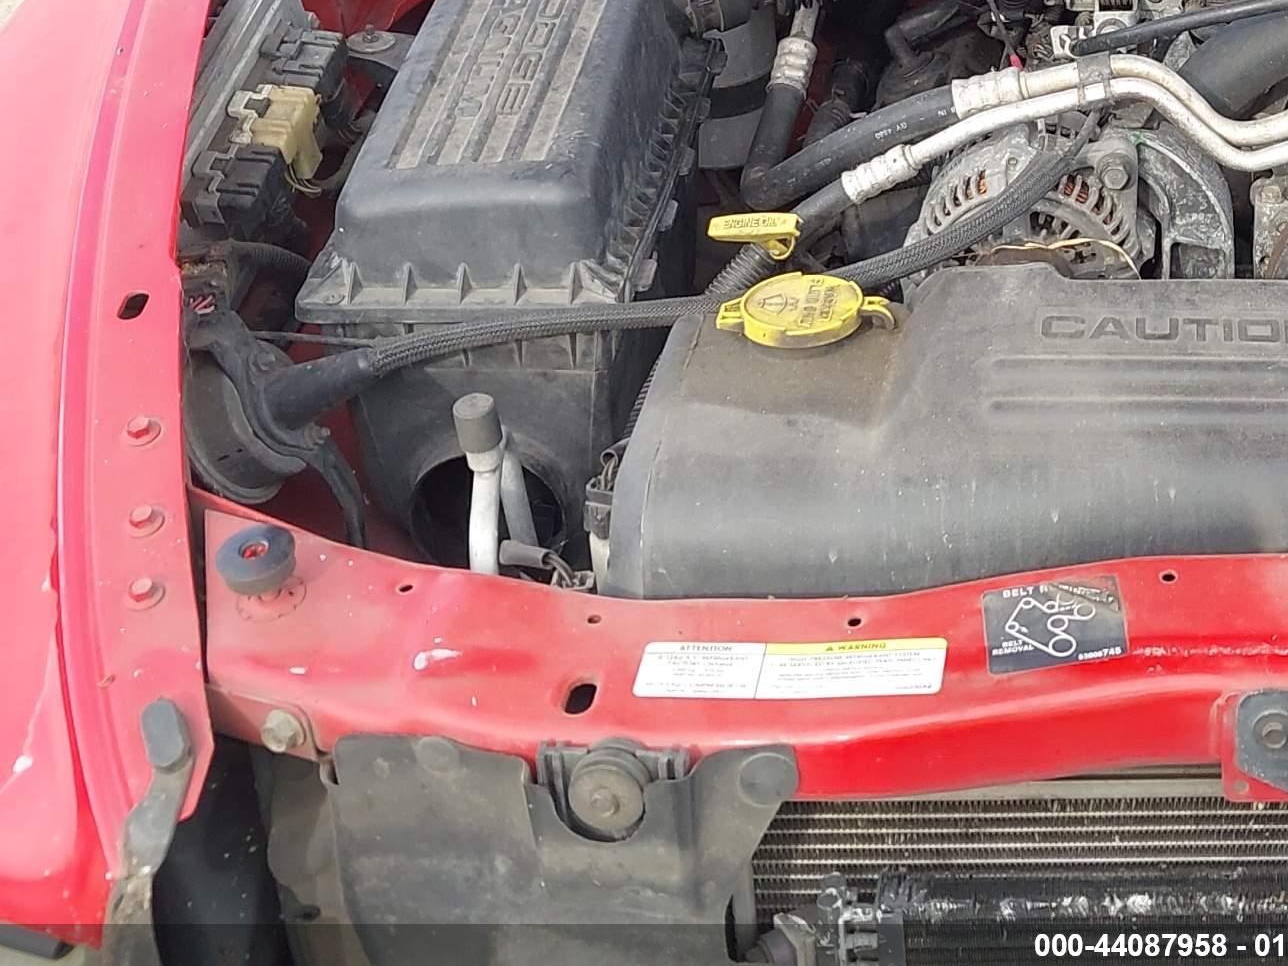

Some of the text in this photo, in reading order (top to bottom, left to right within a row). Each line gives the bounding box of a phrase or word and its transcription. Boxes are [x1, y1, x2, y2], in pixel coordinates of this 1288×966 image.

[723, 217, 778, 229] ENGINE OIL
[1002, 586, 1035, 599] BELT
[679, 644, 733, 652] ATTENTION
[837, 642, 887, 652] WARNING
[991, 643, 1035, 656] REMOVAL
